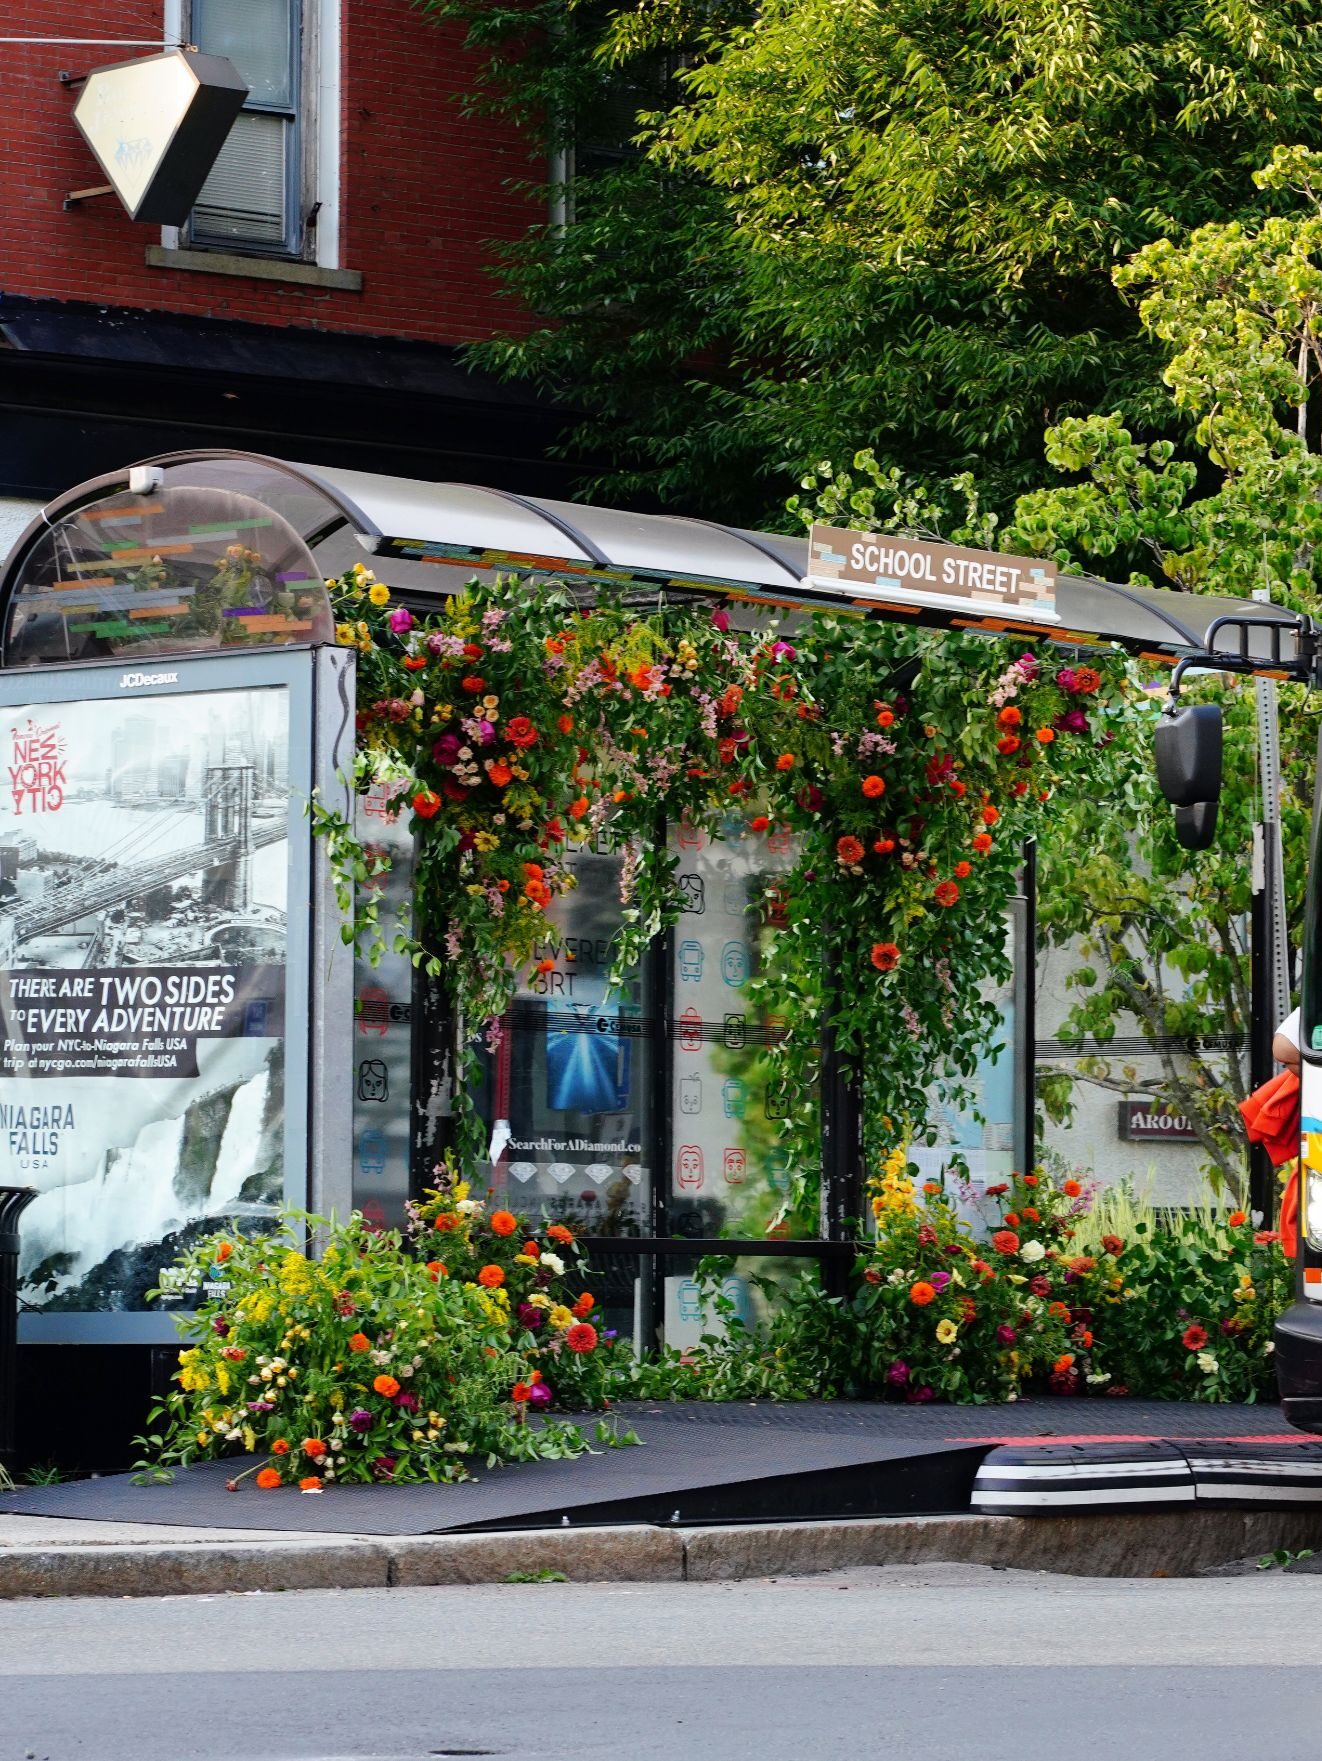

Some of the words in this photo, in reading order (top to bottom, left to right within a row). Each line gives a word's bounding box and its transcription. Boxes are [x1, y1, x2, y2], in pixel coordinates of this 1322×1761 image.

[850, 543, 937, 582] SCHOOL
[942, 558, 1021, 593] STREET
[119, 672, 179, 688] JCDecaux
[14, 733, 58, 764] NEW
[8, 760, 68, 789] YORK
[9, 978, 57, 998] THERE
[58, 977, 95, 997] ARE
[99, 976, 162, 1006] TWO
[164, 974, 236, 1004] SIDES
[10, 1009, 26, 1022] TO
[26, 1008, 91, 1033] EVERY
[91, 1006, 226, 1033] ADVENTURE
[3, 1039, 30, 1053] Plan
[32, 1041, 54, 1055] your
[142, 1037, 164, 1051] Falls
[166, 1037, 188, 1051] USA
[3, 1057, 24, 1071] trip
[28, 1057, 38, 1069] at
[0, 1103, 75, 1130] NIAGARA
[9, 1131, 58, 1156] FALLS
[20, 1159, 49, 1169] USA
